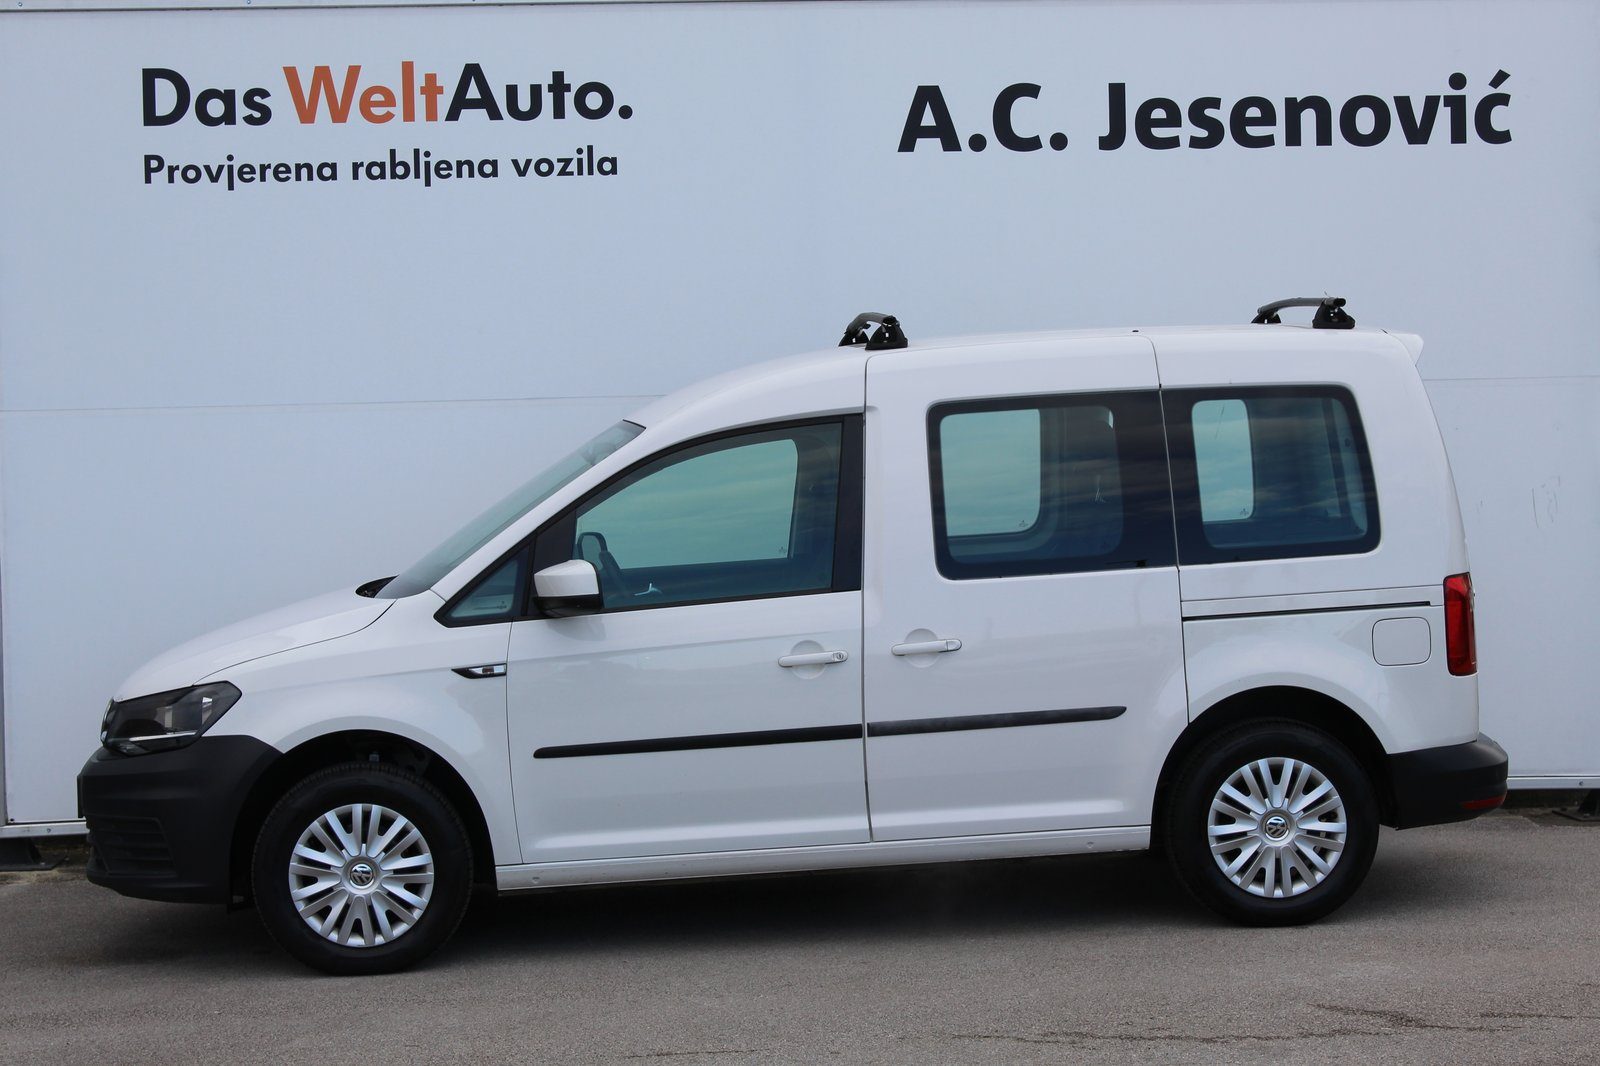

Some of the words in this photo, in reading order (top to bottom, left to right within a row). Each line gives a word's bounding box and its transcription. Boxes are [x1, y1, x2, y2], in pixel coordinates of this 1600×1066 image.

[142, 68, 272, 127] Das
[283, 61, 634, 124] WeltAuto.
[898, 83, 1068, 152] A.C.
[1099, 69, 1512, 150] Jesenović
[144, 154, 338, 191] Provjerena
[352, 148, 499, 187] rabljena
[511, 145, 618, 178] vozila
